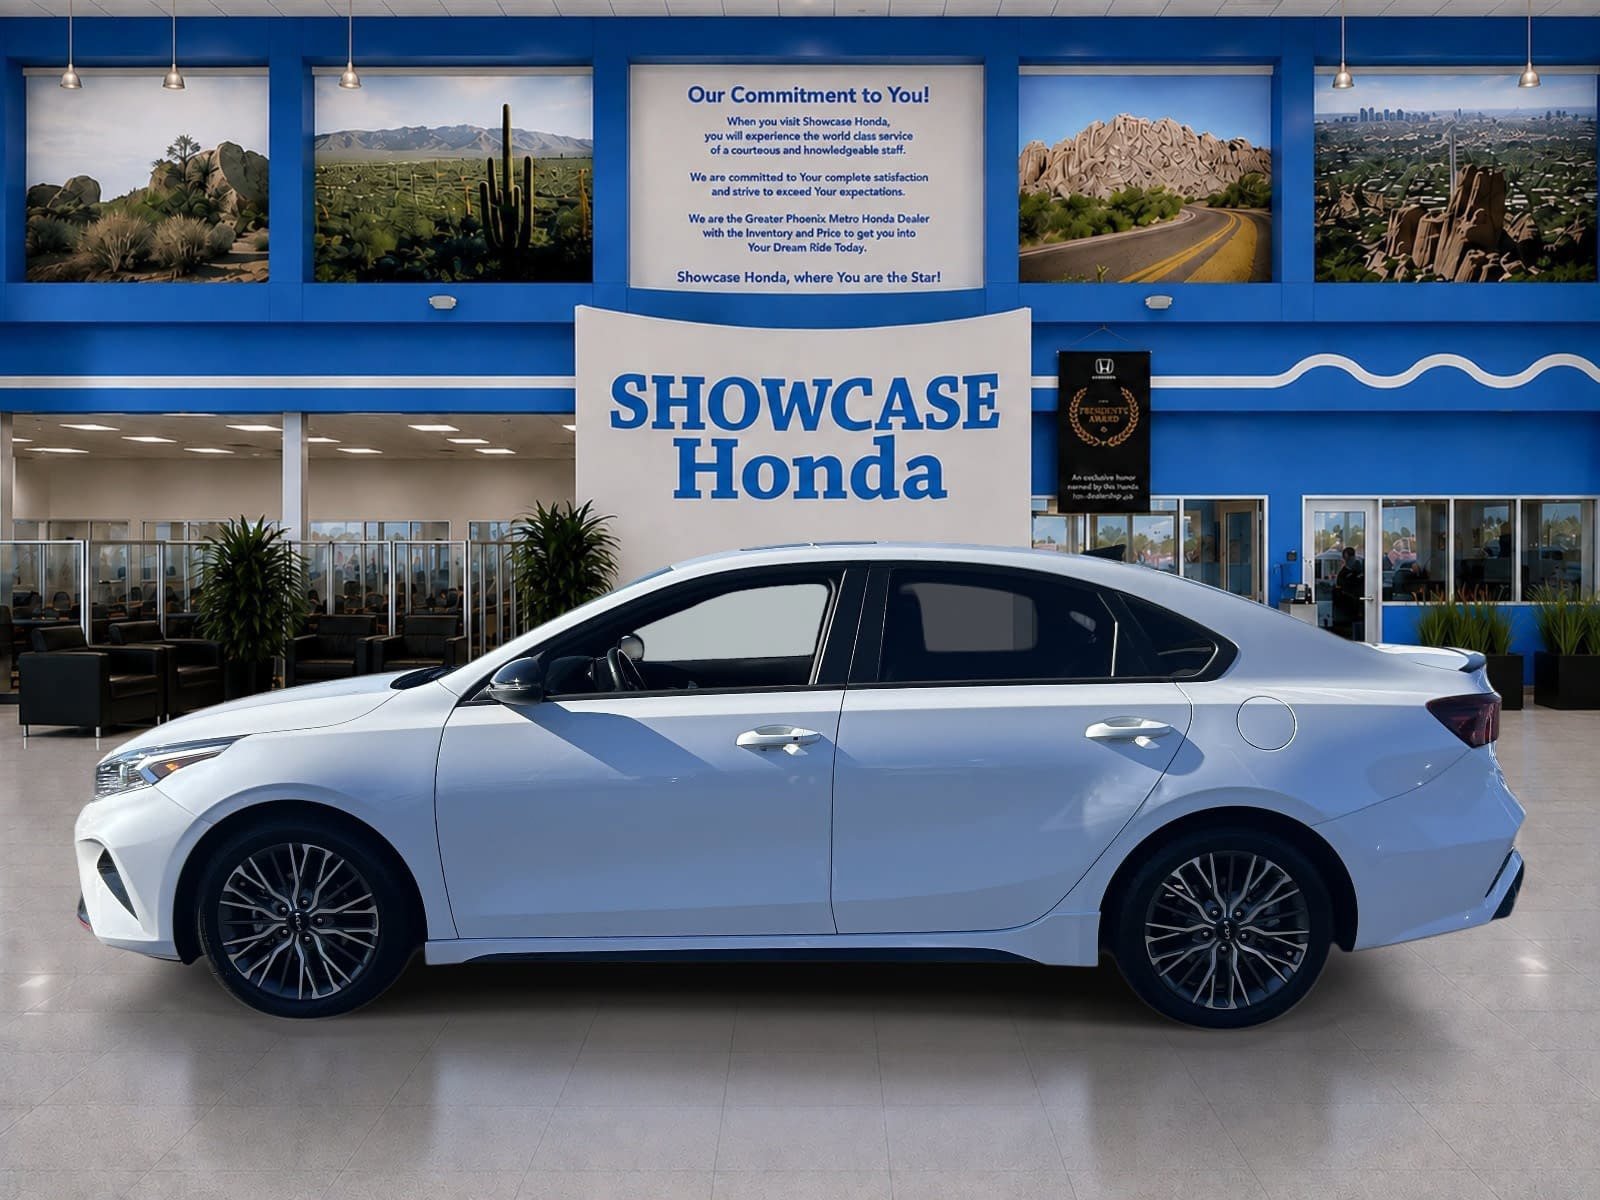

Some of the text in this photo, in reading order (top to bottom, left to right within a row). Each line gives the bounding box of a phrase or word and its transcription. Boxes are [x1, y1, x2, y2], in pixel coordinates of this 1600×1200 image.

[687, 85, 929, 104] Our Commitment to You!
[726, 116, 891, 129] When you visit Showcase Honda,
[704, 130, 914, 144] you will experience the world class service
[710, 144, 721, 155] of
[722, 147, 730, 155] a
[730, 146, 781, 155] courteous
[782, 144, 802, 155] and
[881, 144, 906, 155] staff.
[689, 171, 929, 185] We are committed to Your complete satisfaction
[711, 186, 906, 200] and strive to exceed Your expectations.
[688, 213, 930, 224] We are the Greater Phoenix Metro Honda Dealer
[702, 227, 917, 241] with the Inventory and Price to get you into
[747, 242, 867, 255] Your Dream Ride Today.
[677, 270, 941, 286] Showcase Honda, where You are the Star!
[610, 373, 1000, 431] SHOWCASE
[672, 434, 948, 501] Honda
